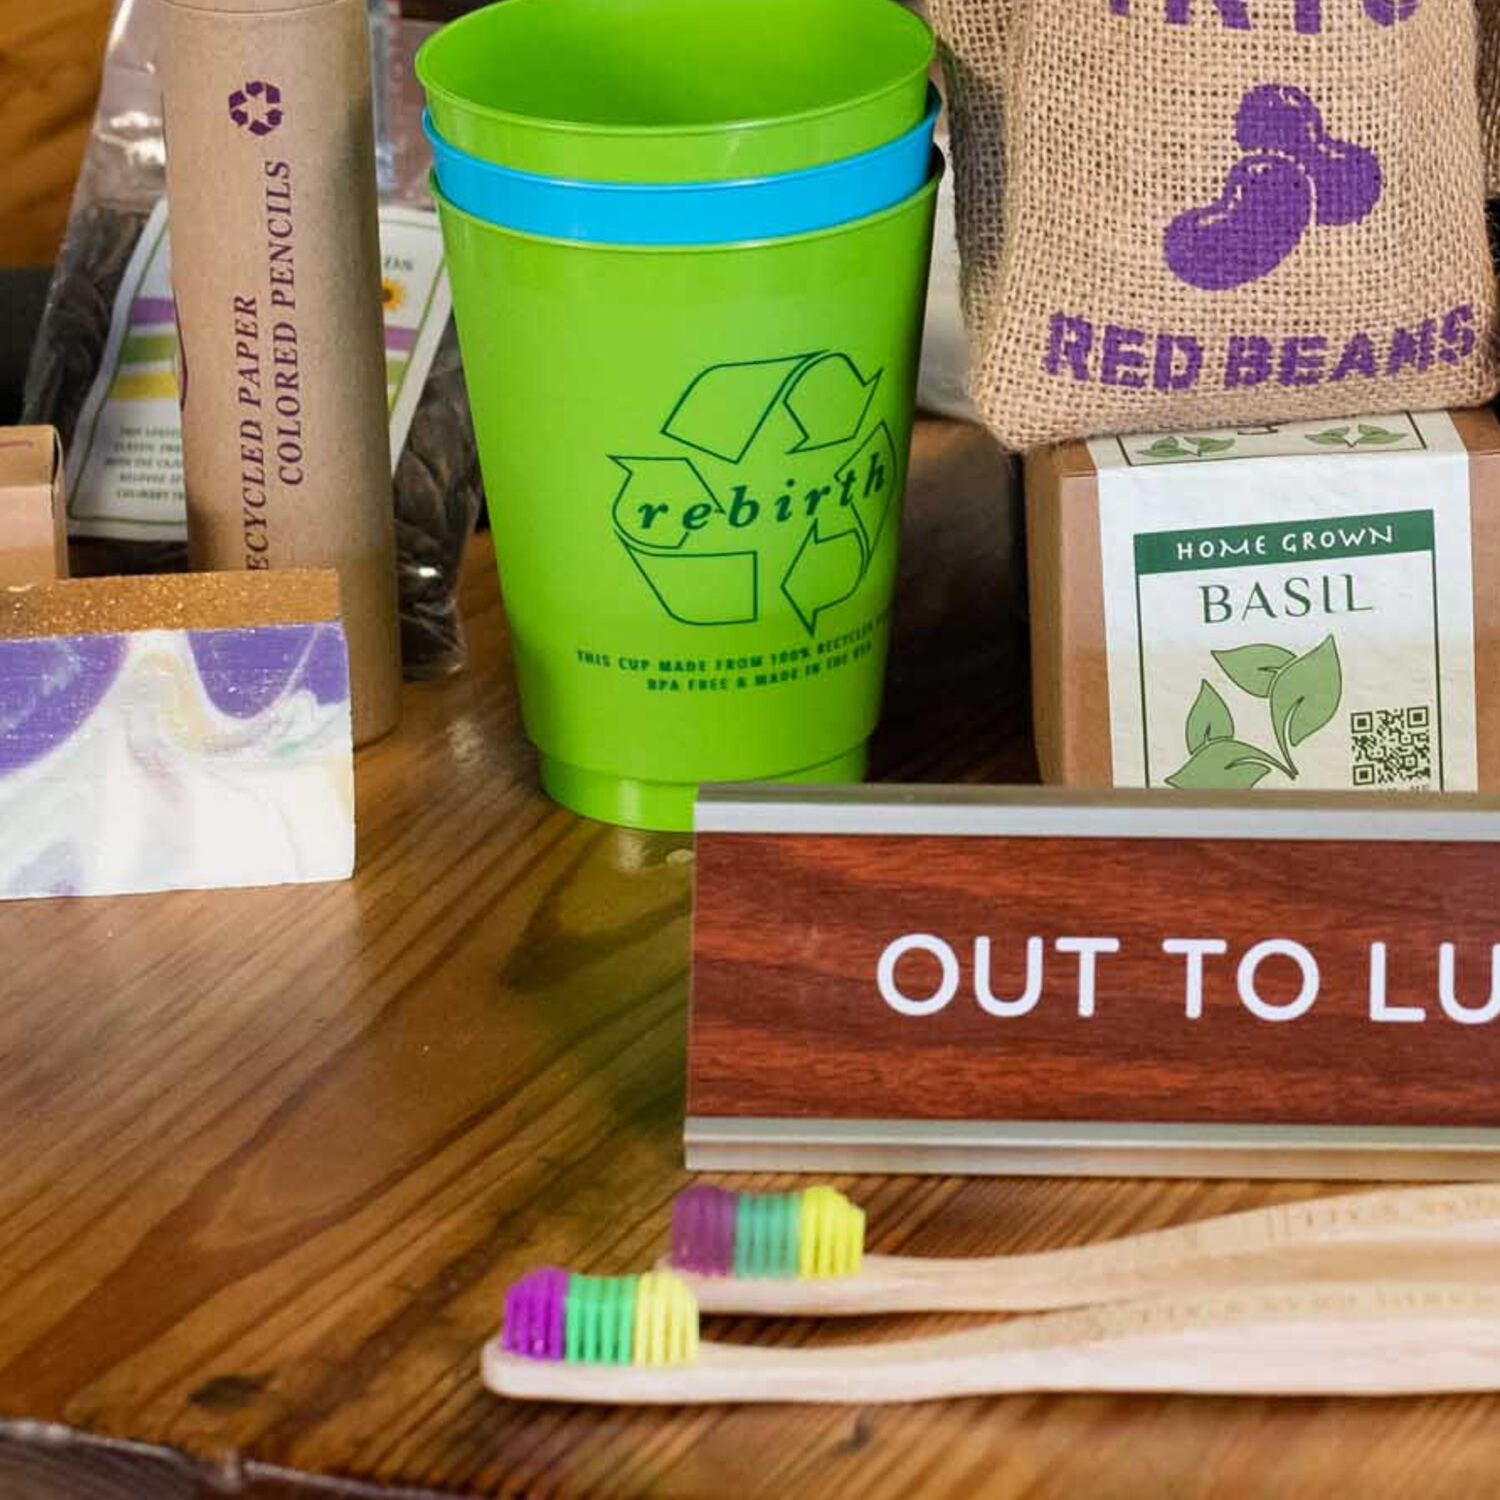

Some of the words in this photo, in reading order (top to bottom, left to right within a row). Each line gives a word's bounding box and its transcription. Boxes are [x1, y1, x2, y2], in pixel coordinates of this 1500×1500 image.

[265, 160, 297, 311] PENCILS
[233, 295, 262, 416] PAPER
[1044, 310, 1203, 391] RED
[1224, 304, 1476, 387] BEANS
[269, 320, 303, 487] COLORED
[239, 421, 270, 571] ECYCLED
[637, 452, 887, 529] rebirth
[1176, 536, 1267, 561] HOME
[1282, 525, 1394, 551] GROWN
[1198, 573, 1375, 624] BASIL
[577, 649, 611, 667] THIS
[618, 656, 650, 671] CUP
[658, 659, 706, 672] MADE
[715, 656, 762, 670] FROM
[646, 678, 679, 691] BPA
[688, 678, 727, 691] FREE
[754, 668, 797, 686] MADE
[876, 933, 1120, 1021] OUT
[1162, 936, 1322, 1025] TO
